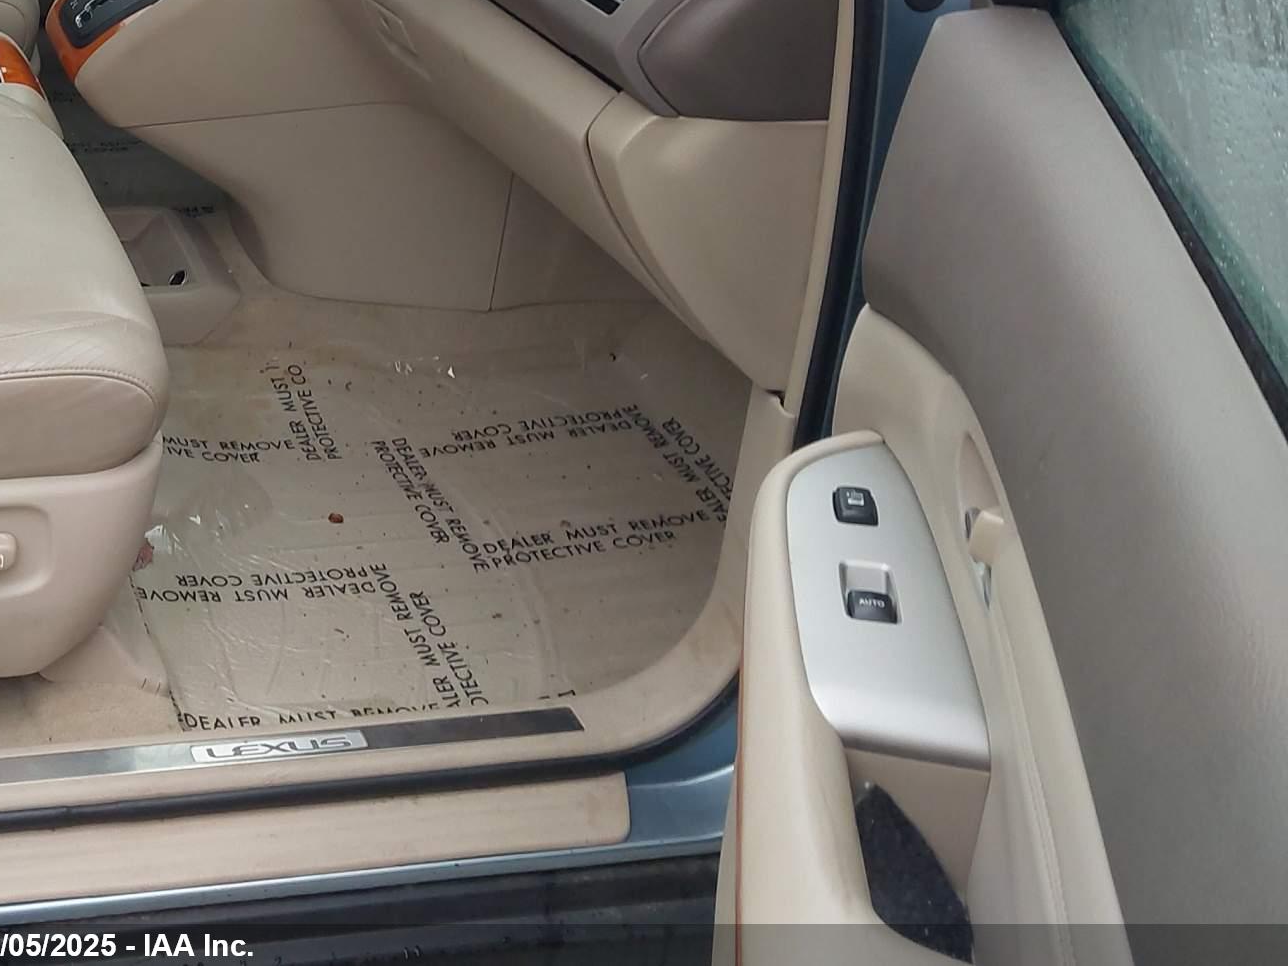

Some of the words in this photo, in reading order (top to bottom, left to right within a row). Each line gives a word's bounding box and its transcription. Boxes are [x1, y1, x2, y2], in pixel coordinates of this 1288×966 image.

[298, 389, 343, 460] PROTECTIVE
[518, 410, 623, 431] PROTECTIVE
[569, 420, 632, 439] DEALER
[289, 420, 322, 461] DEALER
[452, 423, 512, 442] COVER
[507, 430, 555, 446] MUST
[219, 439, 296, 451] REMOVE
[419, 441, 497, 458] REMOVE
[202, 451, 261, 463] COVER
[415, 504, 450, 544] COVER
[483, 532, 554, 555] DEALER
[565, 523, 619, 542] MUST
[628, 509, 711, 531] REMOVE
[492, 540, 607, 569] PROTECTIVE
[612, 530, 677, 550] COVER
[175, 574, 243, 587] COVER
[250, 566, 368, 585] PROTECTIVE
[138, 586, 222, 603] REMOVE
[234, 588, 289, 603] MUST
[303, 581, 377, 599] DEALER
[369, 562, 414, 621] REMOVE
[859, 598, 885, 608] AUTO
[409, 590, 447, 637] COVER
[404, 628, 440, 666] MUST
[206, 736, 353, 759] LEXUS
